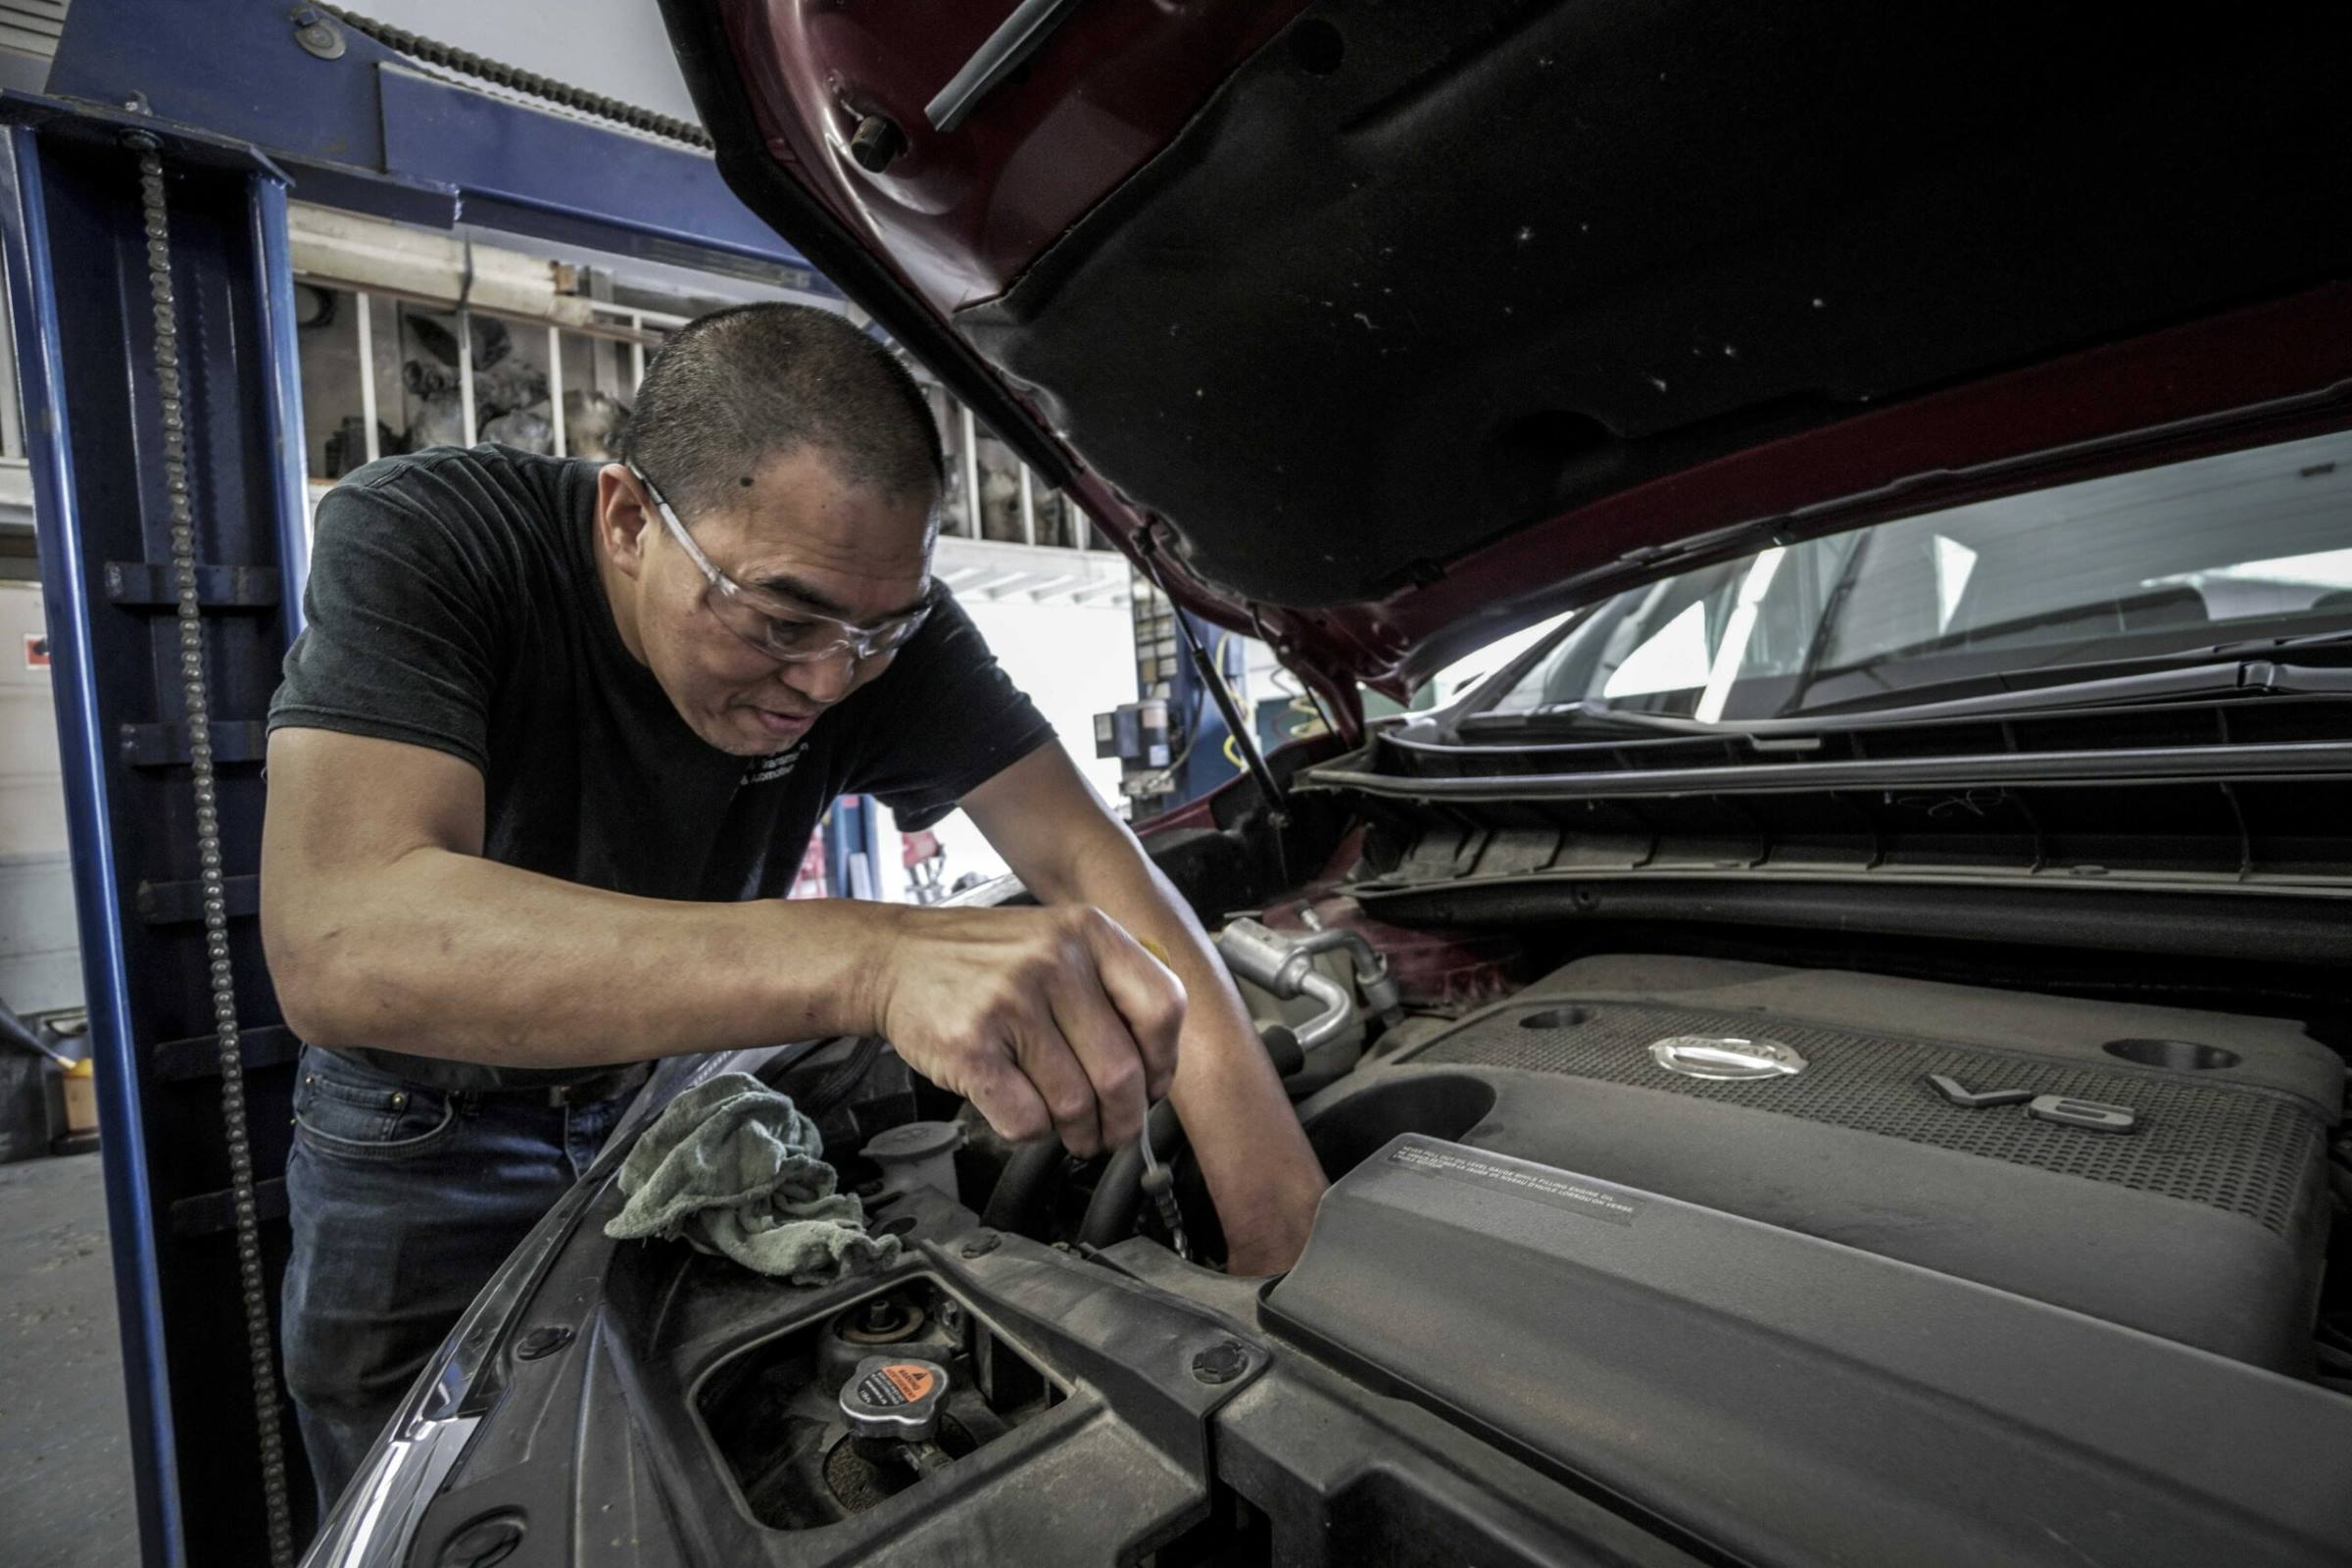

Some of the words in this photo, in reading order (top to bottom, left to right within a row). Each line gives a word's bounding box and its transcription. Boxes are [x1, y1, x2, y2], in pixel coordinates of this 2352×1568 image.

[1926, 1073, 2136, 1134] V6
[1488, 1166, 1512, 1175] GAUGE
[1538, 1179, 1567, 1189] FILLING
[1567, 1186, 1599, 1197] ENGINE
[1499, 1175, 1527, 1184] NIVEAU
[1605, 1201, 1634, 1212] VERSE
